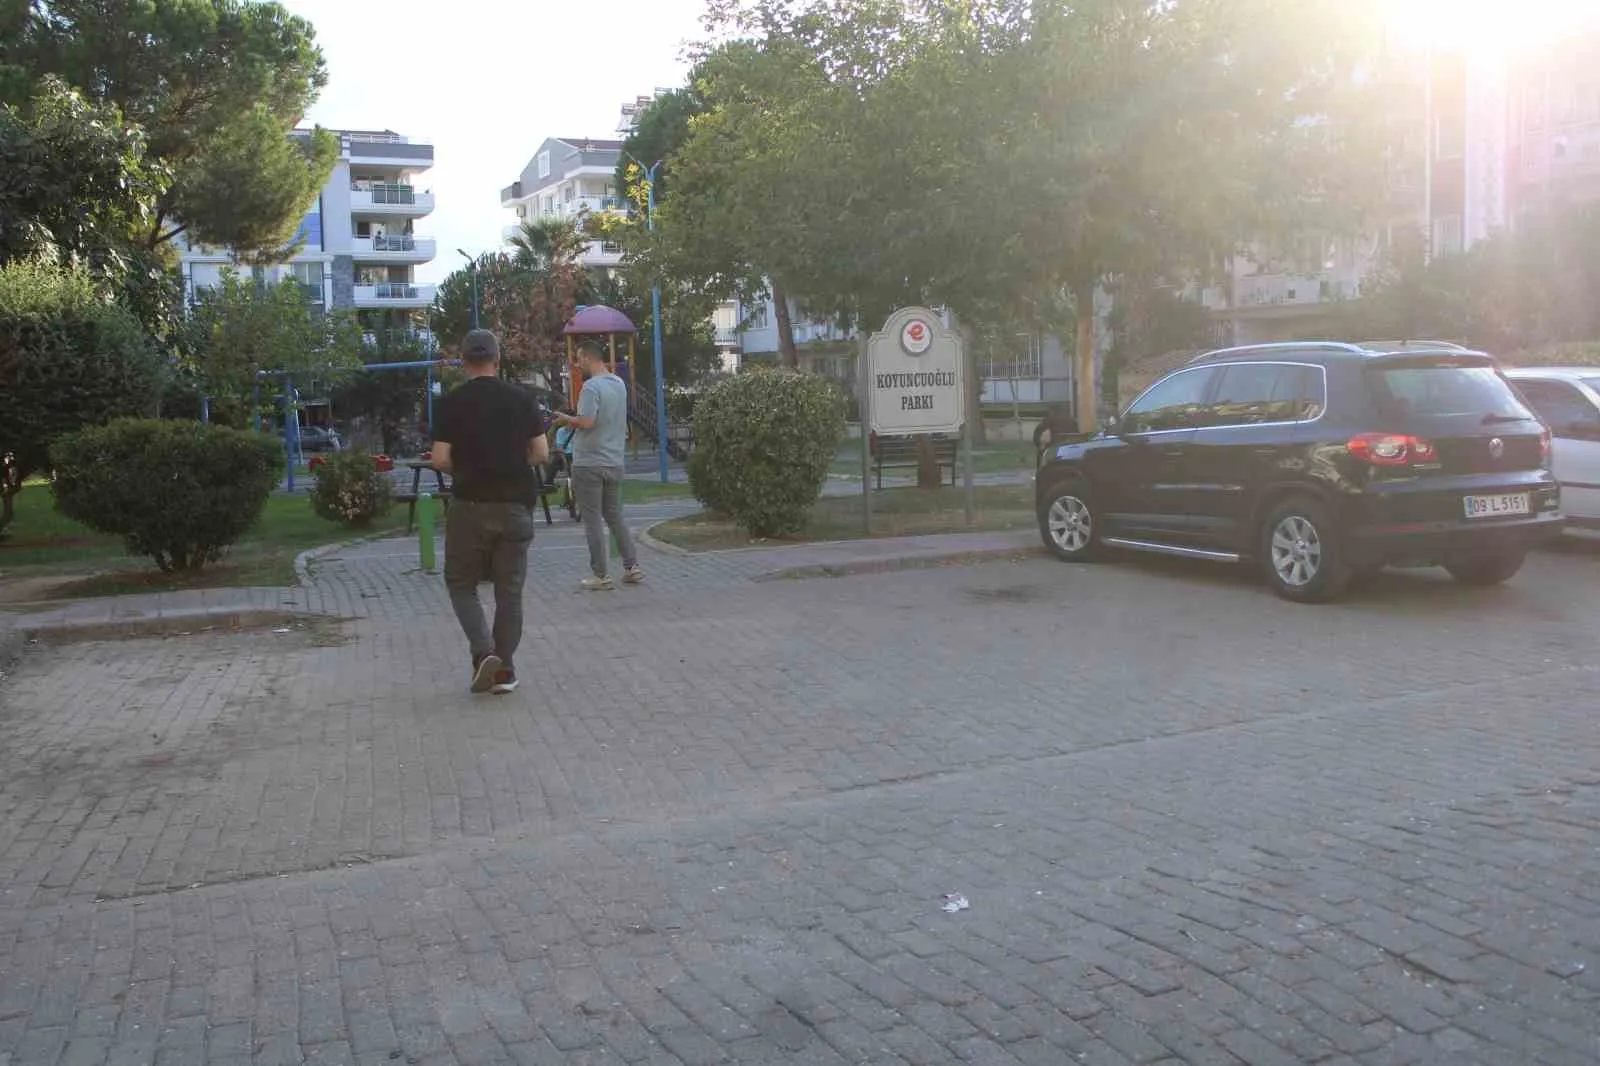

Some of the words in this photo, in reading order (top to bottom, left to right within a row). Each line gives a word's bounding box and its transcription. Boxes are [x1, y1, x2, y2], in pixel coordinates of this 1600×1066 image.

[876, 369, 955, 389] KOYUNCUOĞLU
[901, 395, 934, 410] PARKI
[1473, 498, 1488, 513] 09
[1491, 498, 1501, 512] L
[1501, 496, 1526, 511] 5151
